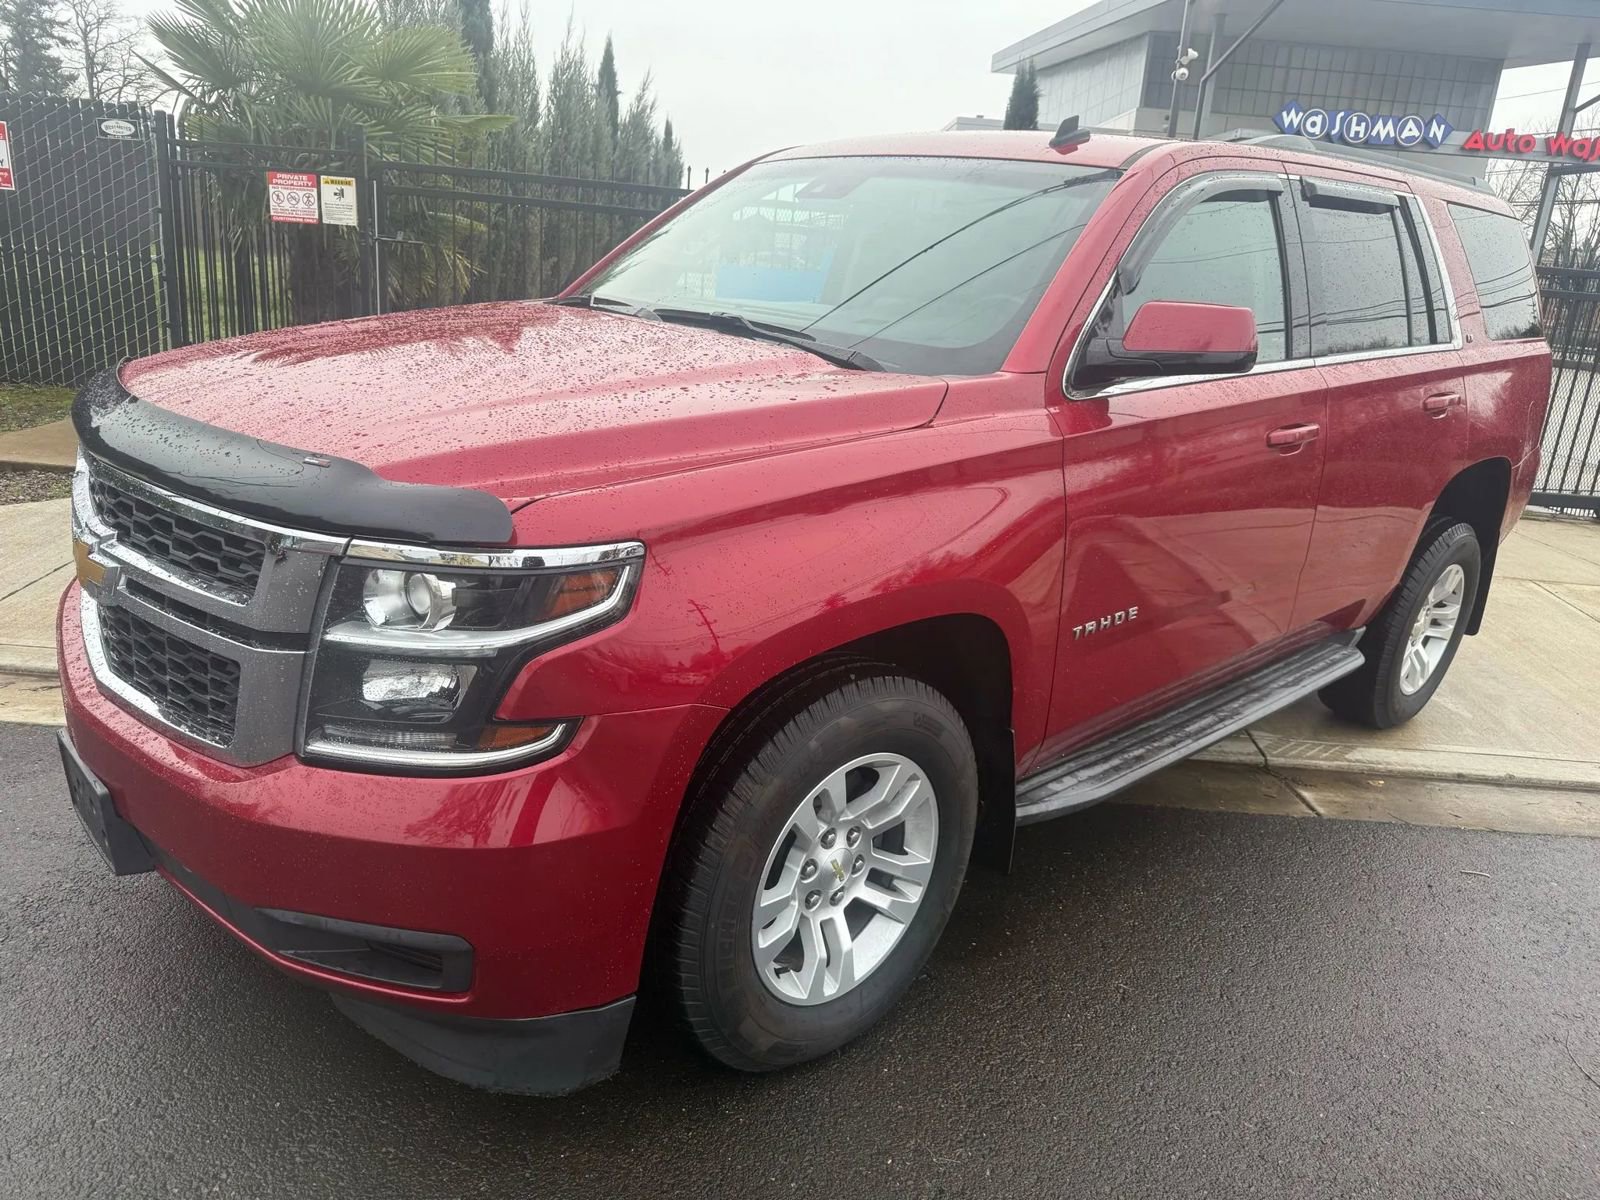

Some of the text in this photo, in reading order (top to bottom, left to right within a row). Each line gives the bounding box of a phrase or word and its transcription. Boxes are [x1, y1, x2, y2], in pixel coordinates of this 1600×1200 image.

[1463, 128, 1536, 153] Auto
[272, 178, 313, 187] PROPERTY
[276, 173, 308, 181] PRIVATE
[1073, 606, 1138, 640] TAHOE
